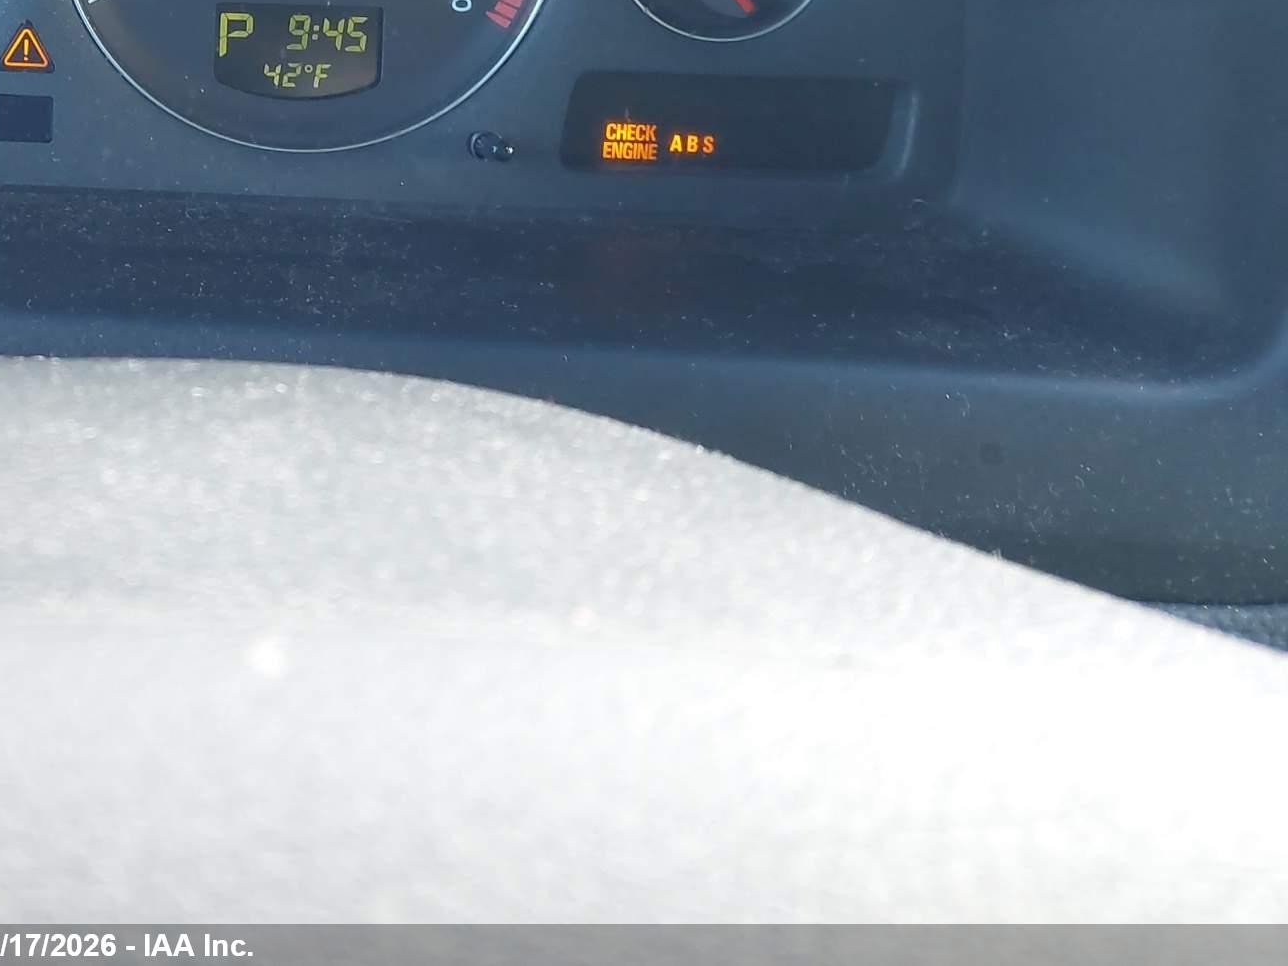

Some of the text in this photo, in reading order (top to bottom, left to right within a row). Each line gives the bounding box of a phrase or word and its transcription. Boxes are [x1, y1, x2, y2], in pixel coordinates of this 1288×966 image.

[218, 12, 368, 57] P 9:45
[263, 63, 332, 89] 42°F
[605, 122, 657, 141] CHECK
[602, 142, 658, 160] ENGINE
[670, 134, 714, 153] ABS
